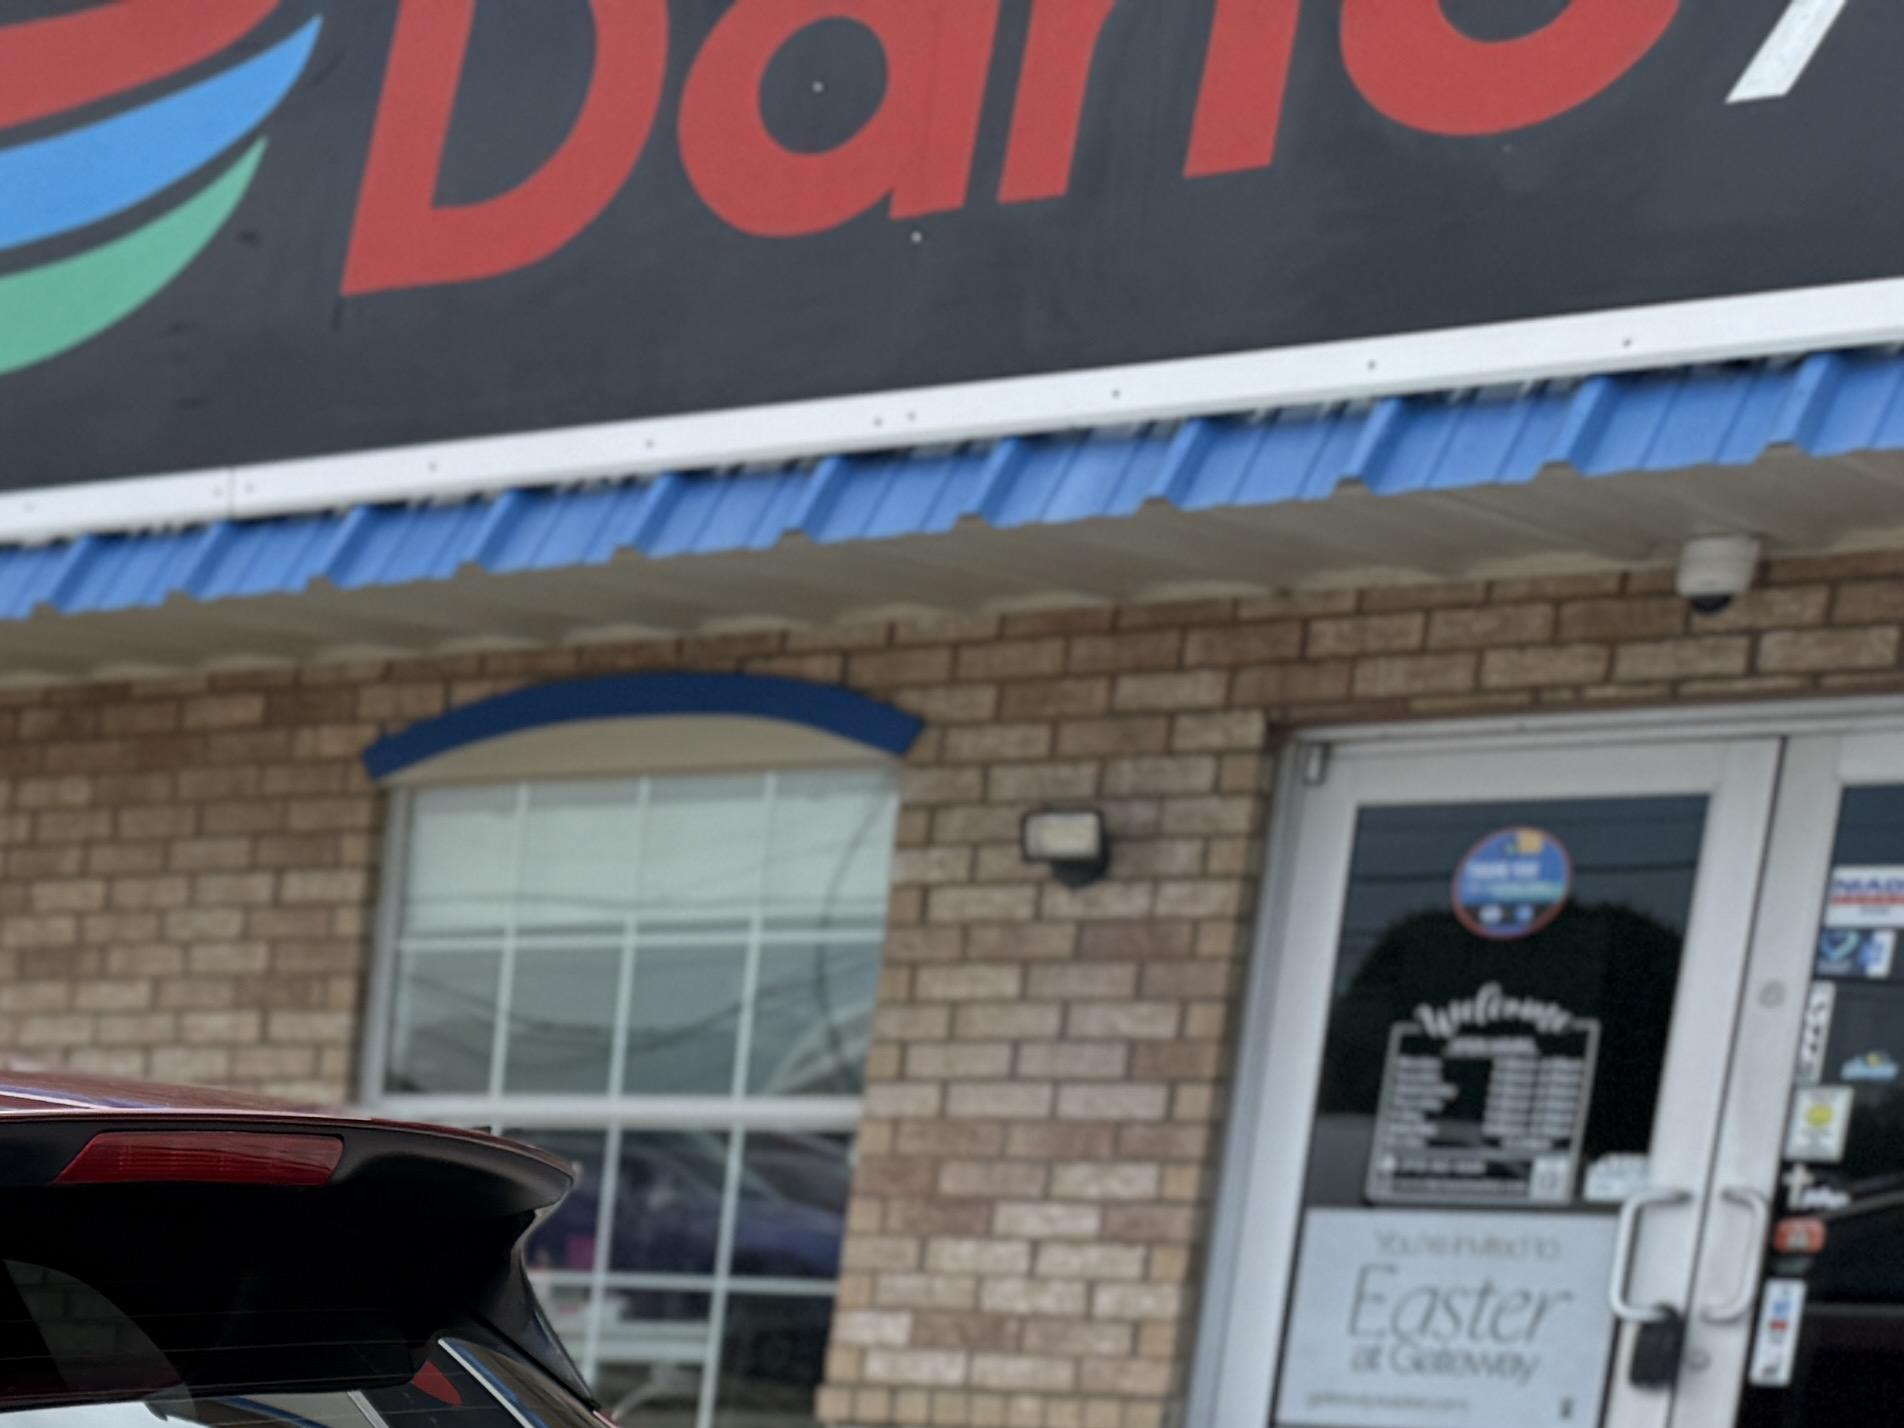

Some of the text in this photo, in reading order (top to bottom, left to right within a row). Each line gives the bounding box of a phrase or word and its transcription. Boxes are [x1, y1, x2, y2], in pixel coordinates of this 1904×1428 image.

[1348, 1263, 1574, 1343] Easter
[1351, 1343, 1539, 1386] at Gateway
